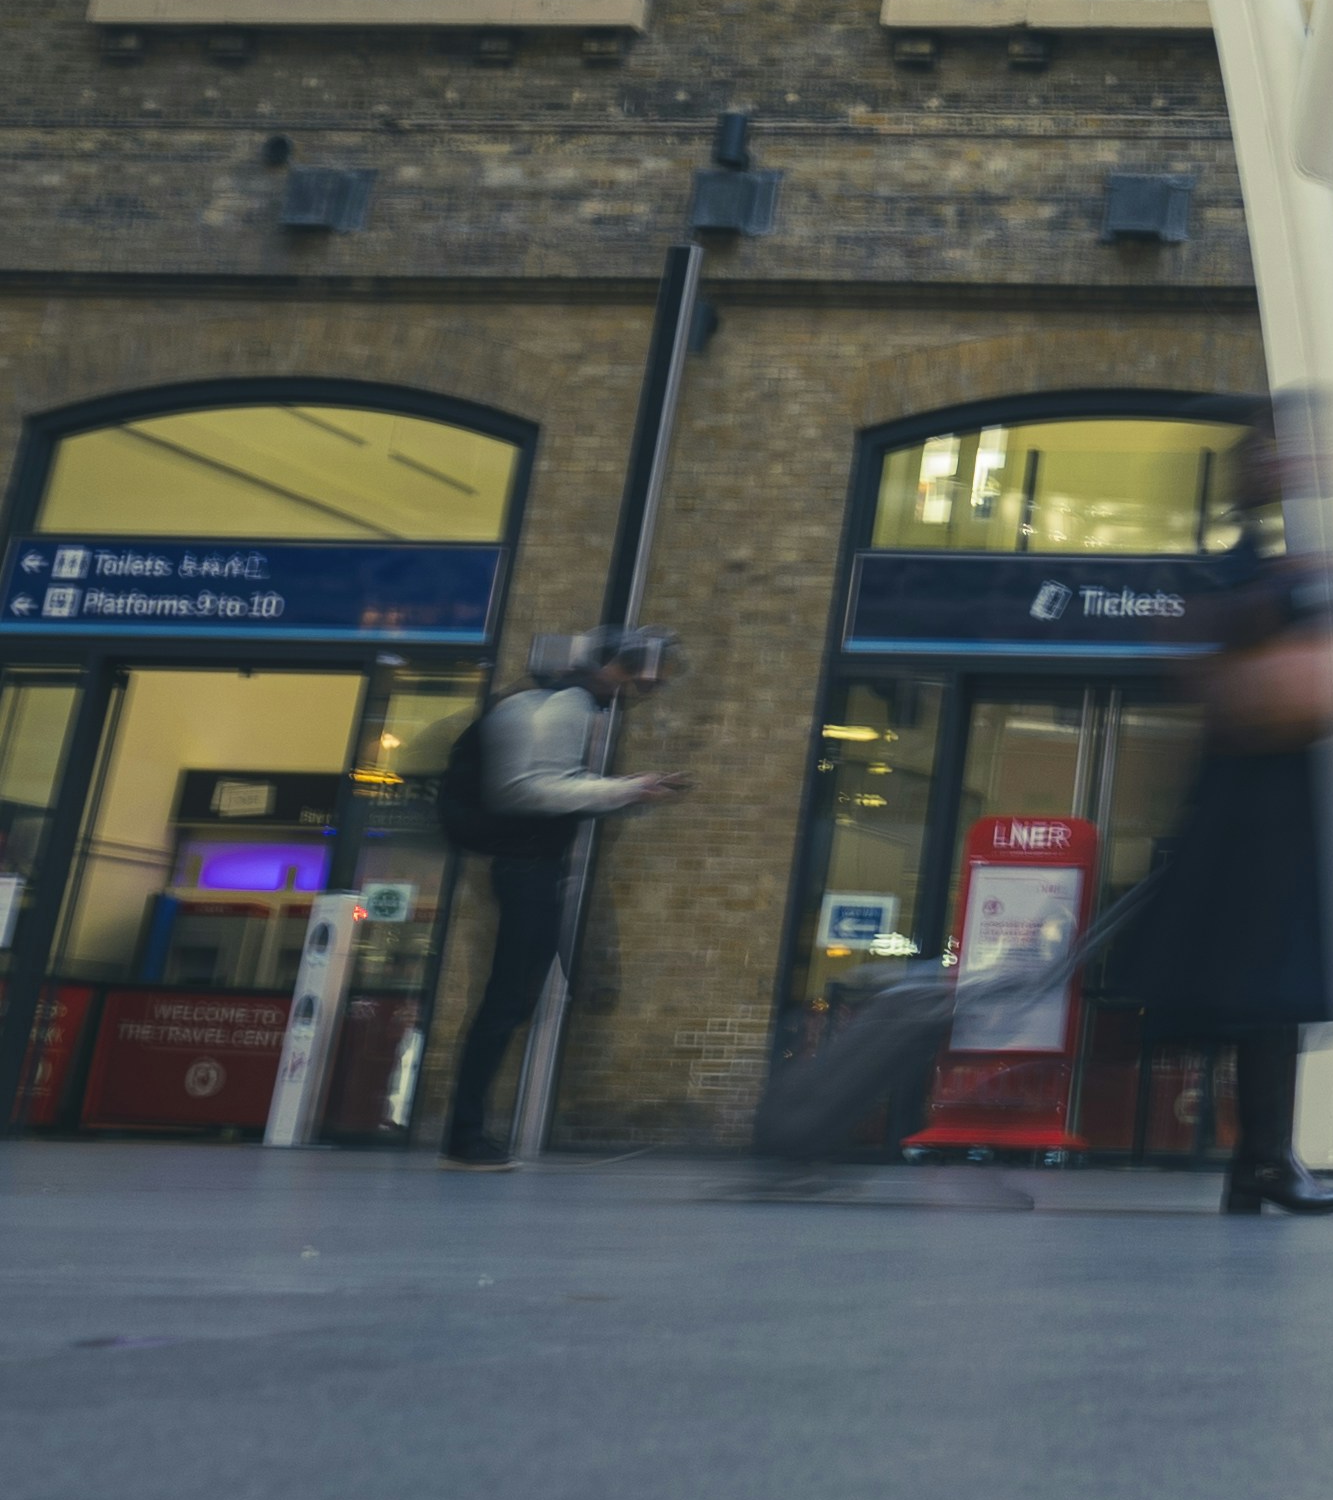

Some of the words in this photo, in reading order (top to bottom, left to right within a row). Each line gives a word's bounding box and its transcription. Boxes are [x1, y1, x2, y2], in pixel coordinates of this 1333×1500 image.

[94, 551, 172, 576] Toilets
[83, 588, 198, 616] Platforms
[217, 593, 247, 616] to
[249, 591, 285, 617] 10
[1079, 585, 1185, 617] Tickets
[992, 819, 1072, 849] LNER
[152, 1002, 250, 1024] WELCOME
[252, 1008, 284, 1025] TO
[116, 1020, 156, 1041] THE
[155, 1023, 227, 1045] TRAVEL
